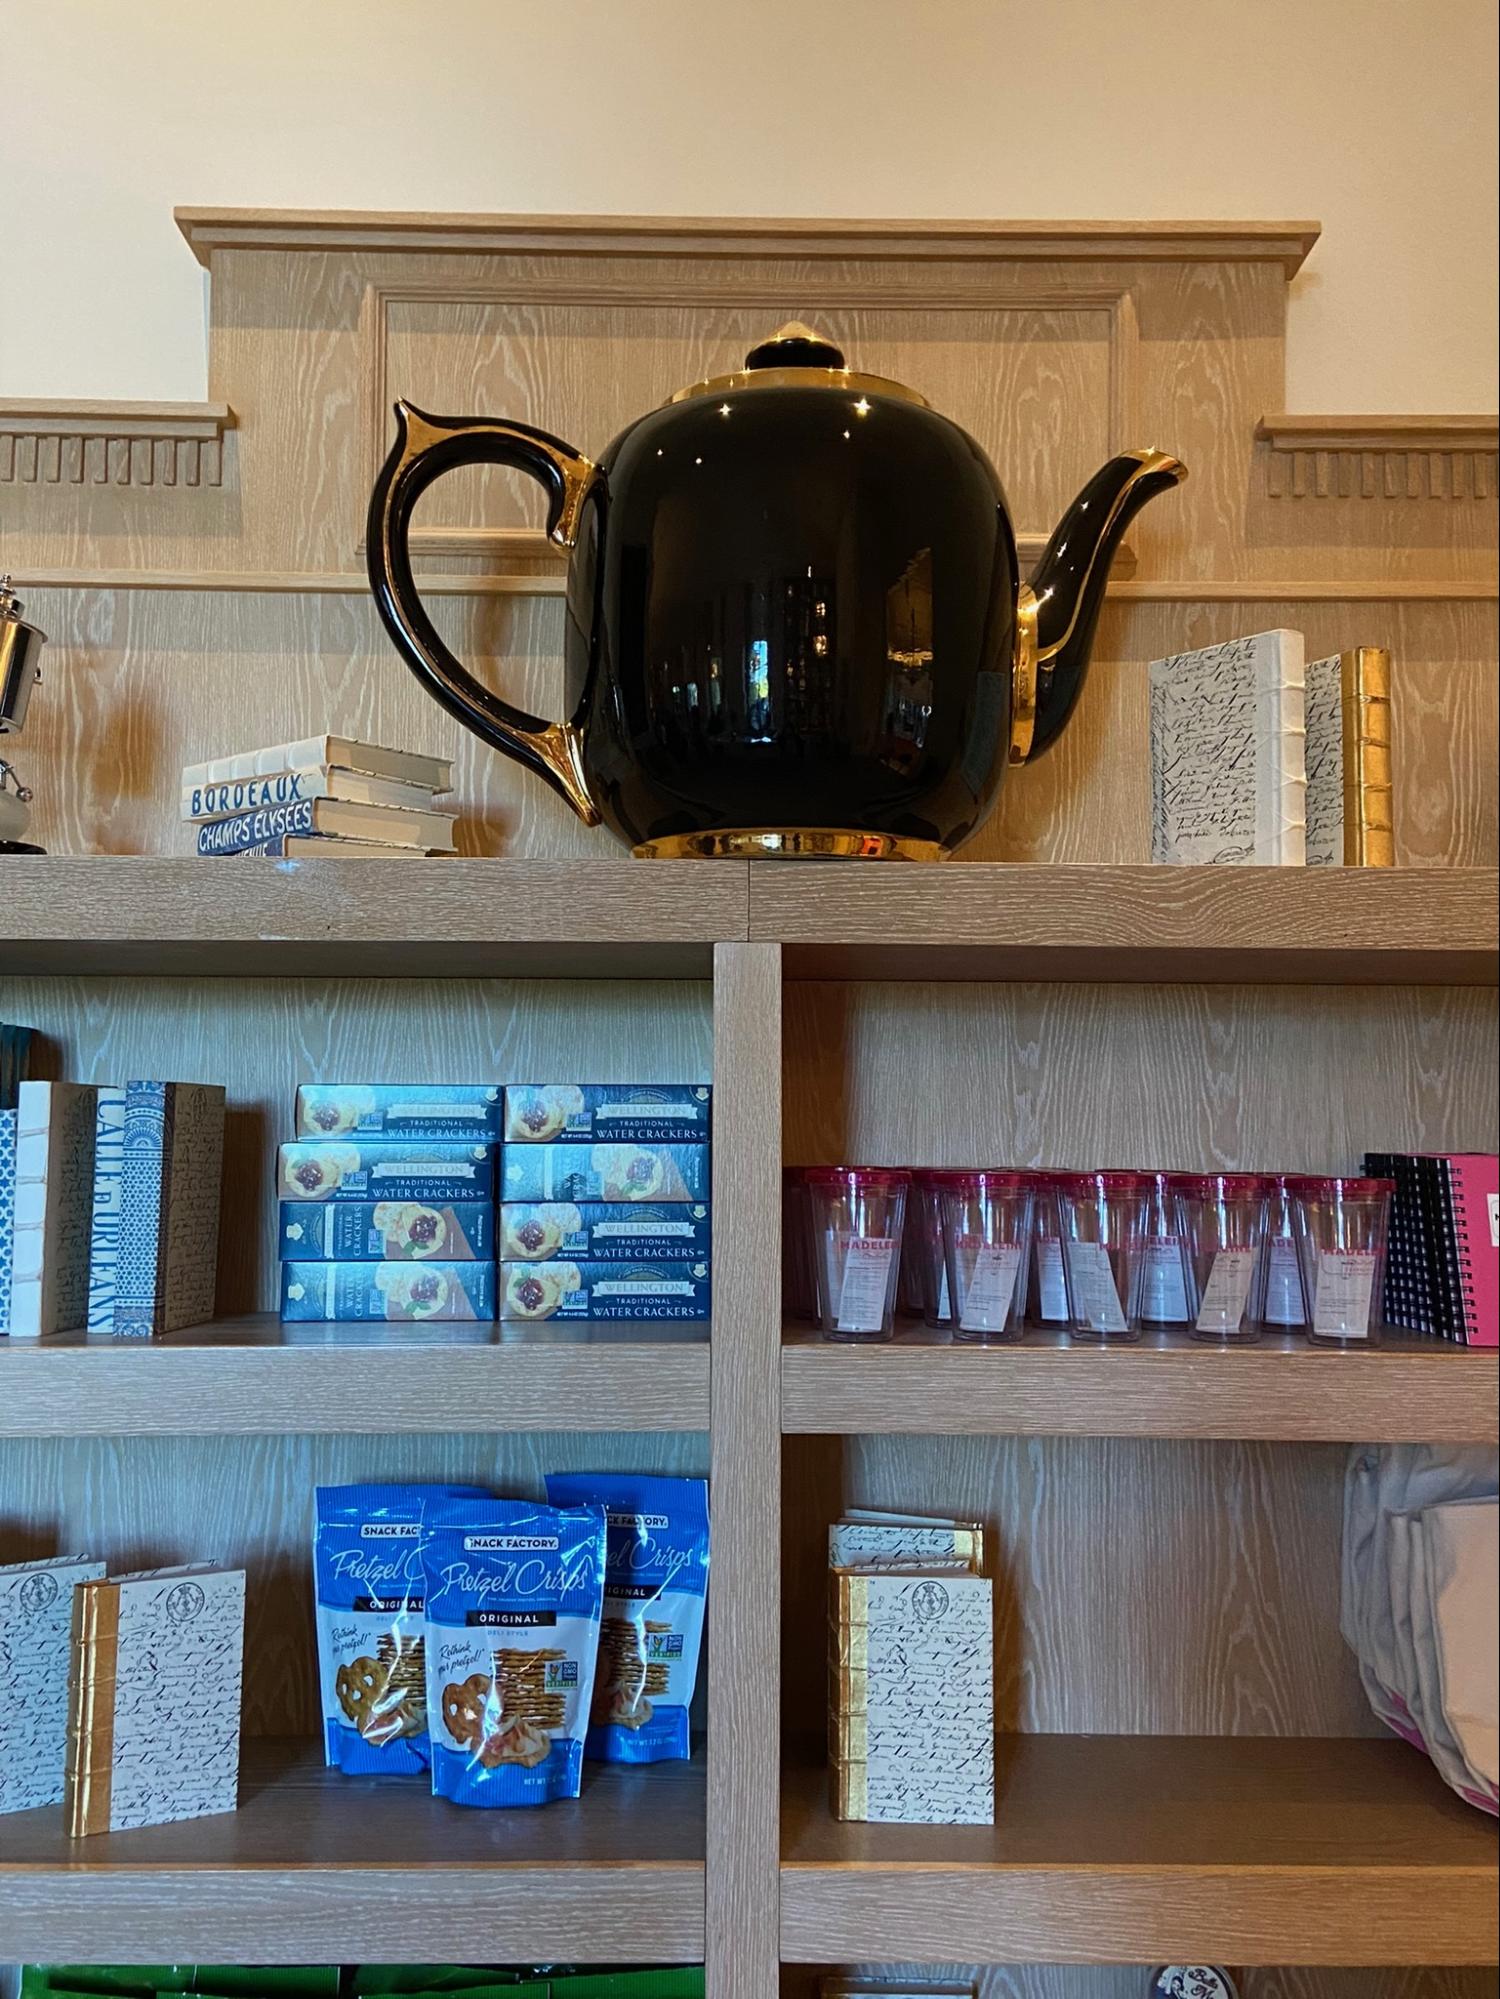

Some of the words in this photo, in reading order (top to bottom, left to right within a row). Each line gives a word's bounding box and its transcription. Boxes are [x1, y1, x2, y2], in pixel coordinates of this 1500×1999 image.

[191, 772, 302, 815] BORDEAUX
[199, 817, 250, 852] CHAMPS
[608, 1105, 688, 1115] WELLINGTON
[387, 1128, 425, 1138] WATER
[427, 1128, 486, 1138] CRACKERS
[597, 1129, 635, 1139] WATER
[638, 1129, 697, 1139] CRACKERS
[384, 1164, 464, 1175] WELLINGTON
[373, 1188, 411, 1198] WATER
[414, 1188, 474, 1198] CRACKERS
[345, 1215, 353, 1248] WATER
[354, 1206, 362, 1256] CRACKERS
[604, 1223, 684, 1234] WELLINGTON
[594, 1248, 632, 1258] WATER
[635, 1248, 695, 1257] CRACKERS
[604, 1283, 684, 1294] WELLINGTON
[594, 1307, 632, 1317] WATER
[635, 1307, 695, 1317] CRACKERS
[363, 1526, 396, 1536] SNACK
[629, 1537, 693, 1577] Crisps
[330, 1549, 408, 1591] Pretzel
[440, 1561, 517, 1607] Pretzel
[515, 1559, 588, 1602] Crisps
[606, 1586, 646, 1597] IGINAL
[369, 1600, 424, 1610] ORIGIAL
[479, 1614, 539, 1624] ORIGINAL
[440, 1640, 472, 1659] Rethink
